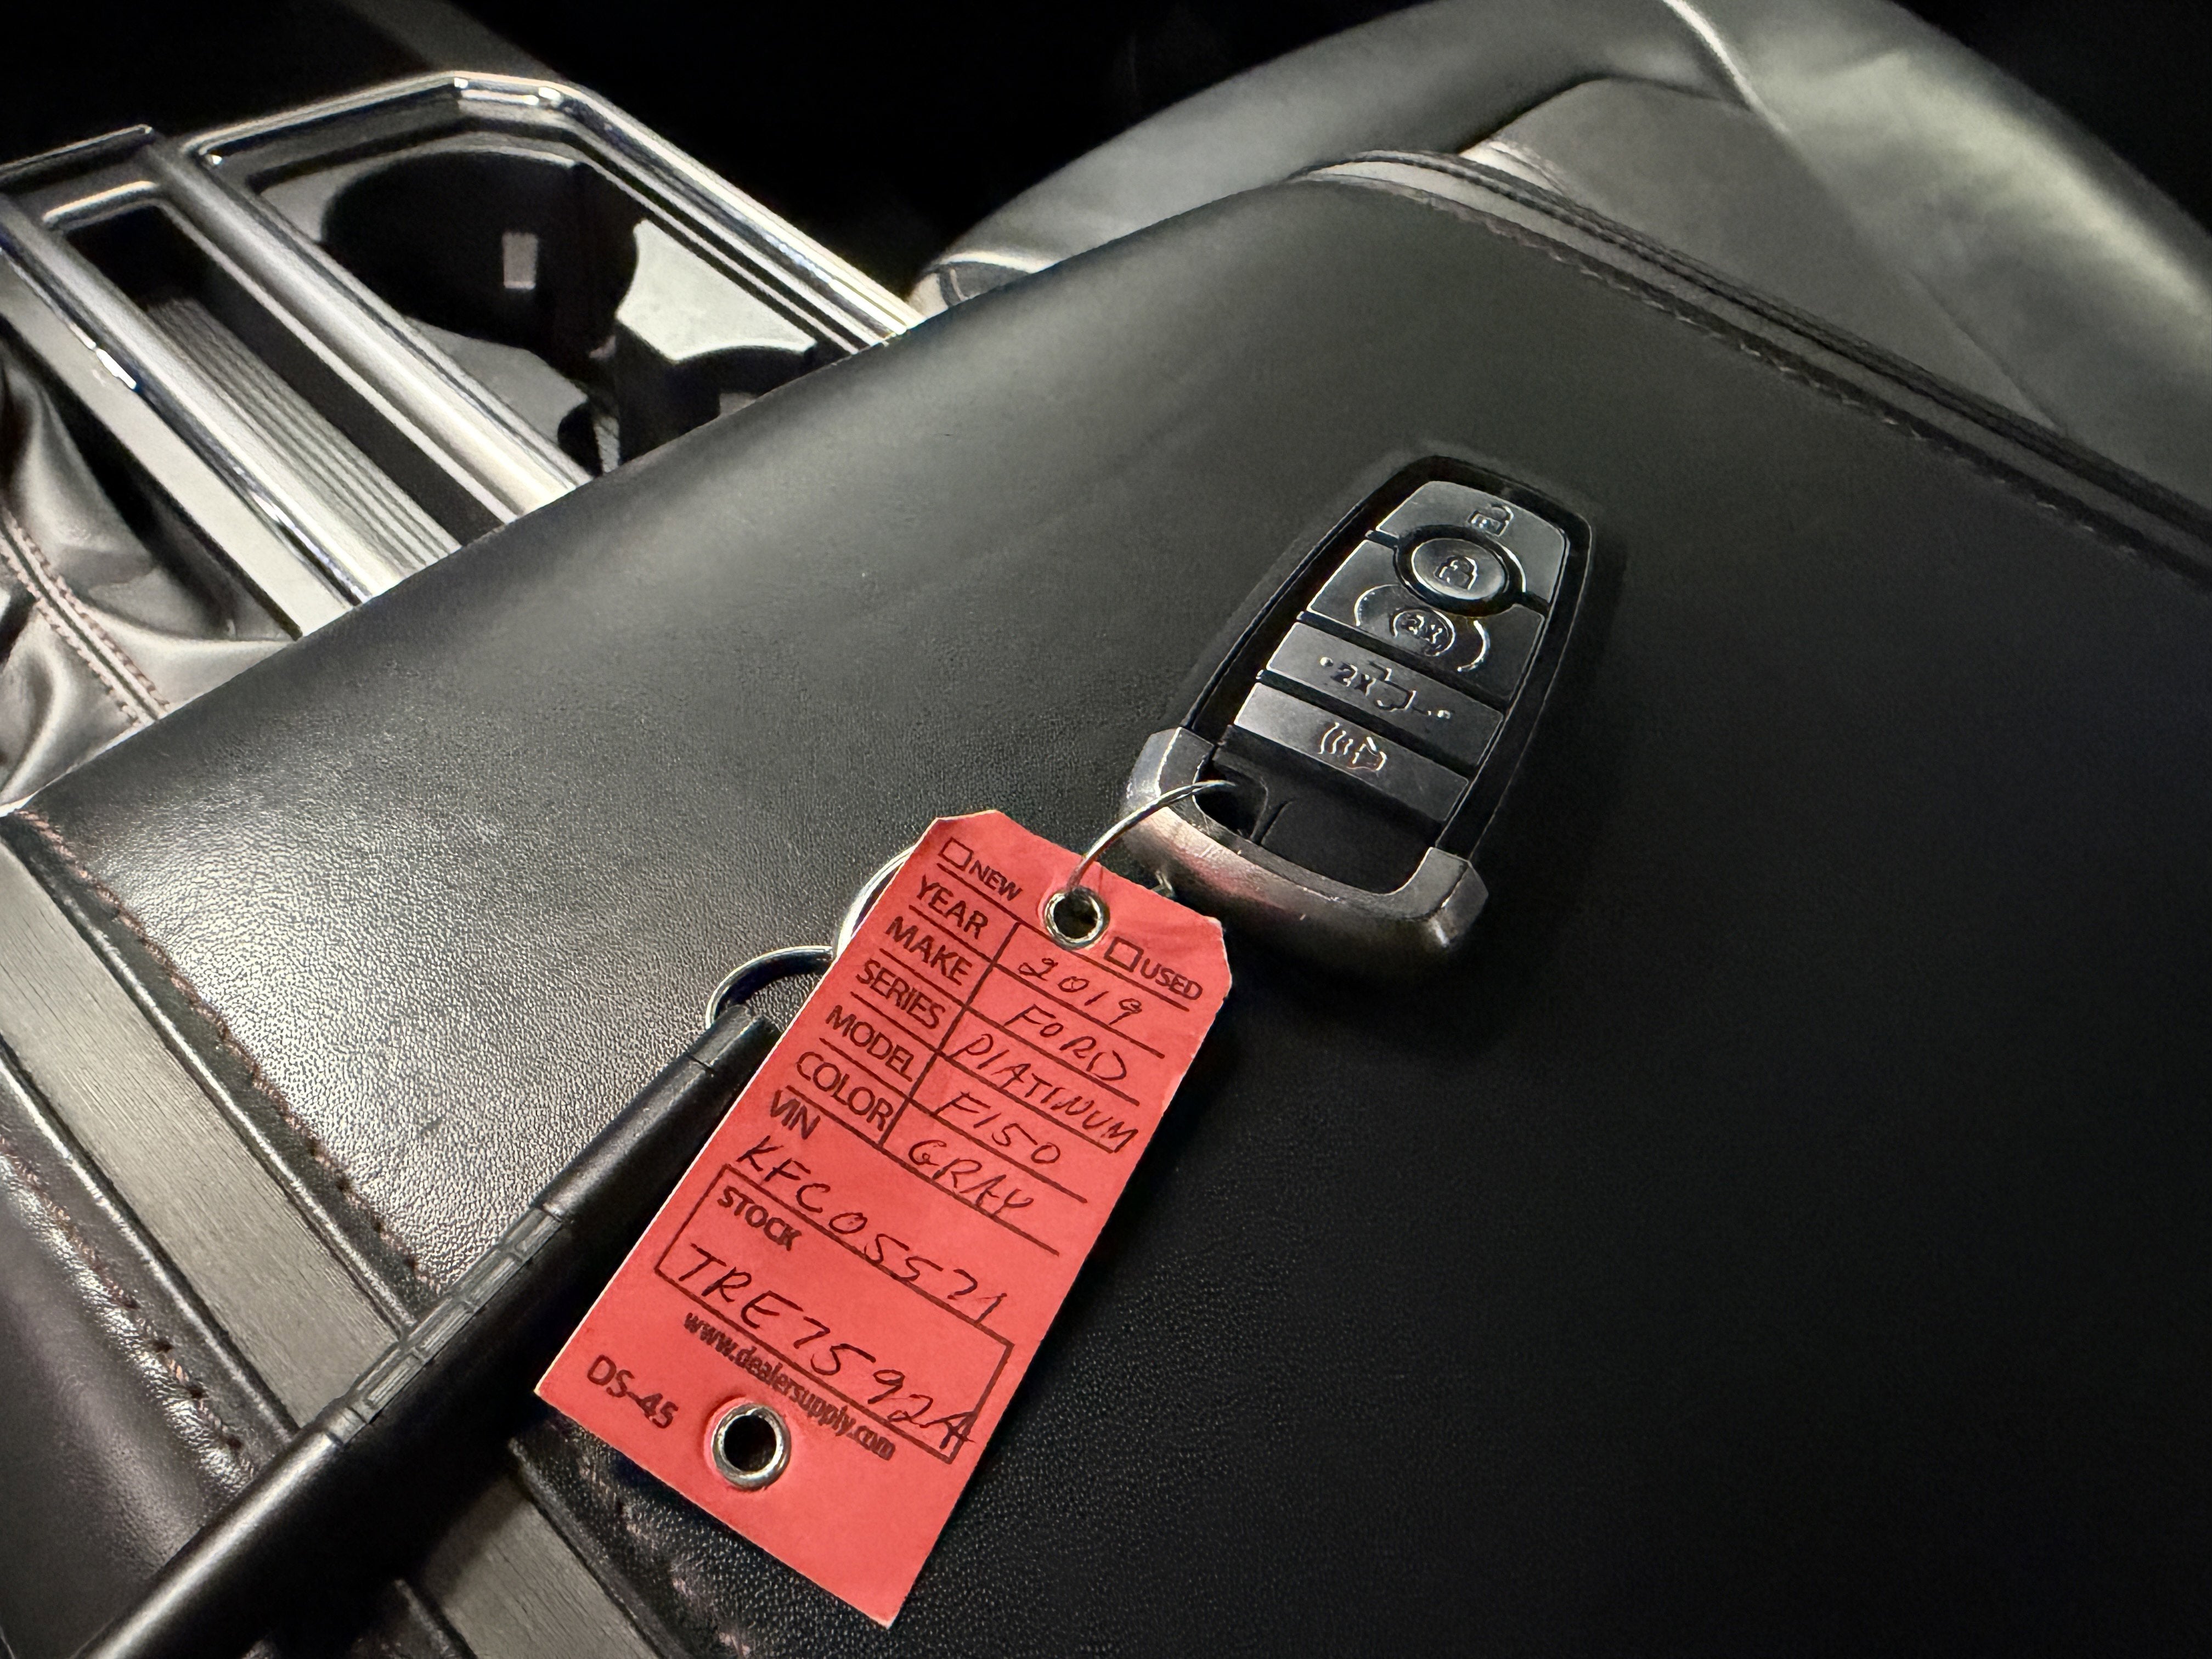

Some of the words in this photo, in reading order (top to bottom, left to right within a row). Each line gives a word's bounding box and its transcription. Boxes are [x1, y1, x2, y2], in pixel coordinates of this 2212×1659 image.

[916, 875, 988, 939] YEAR
[969, 860, 1023, 901] NEW
[884, 916, 973, 985] MAKE
[1141, 958, 1203, 1000] USED
[856, 958, 945, 1029] SERIES
[1018, 958, 1142, 1025] 2019
[826, 1005, 914, 1082] MODEL
[770, 1090, 820, 1139] VIN
[797, 1052, 894, 1131] COLOR
[946, 1034, 1138, 1153] PLATINUM
[933, 1091, 1060, 1164] F150
[909, 1139, 1034, 1218] GRAY
[717, 1186, 802, 1252] STOCK
[586, 1354, 679, 1429] DS-45
[684, 1312, 895, 1461] www.dealersupply.com
